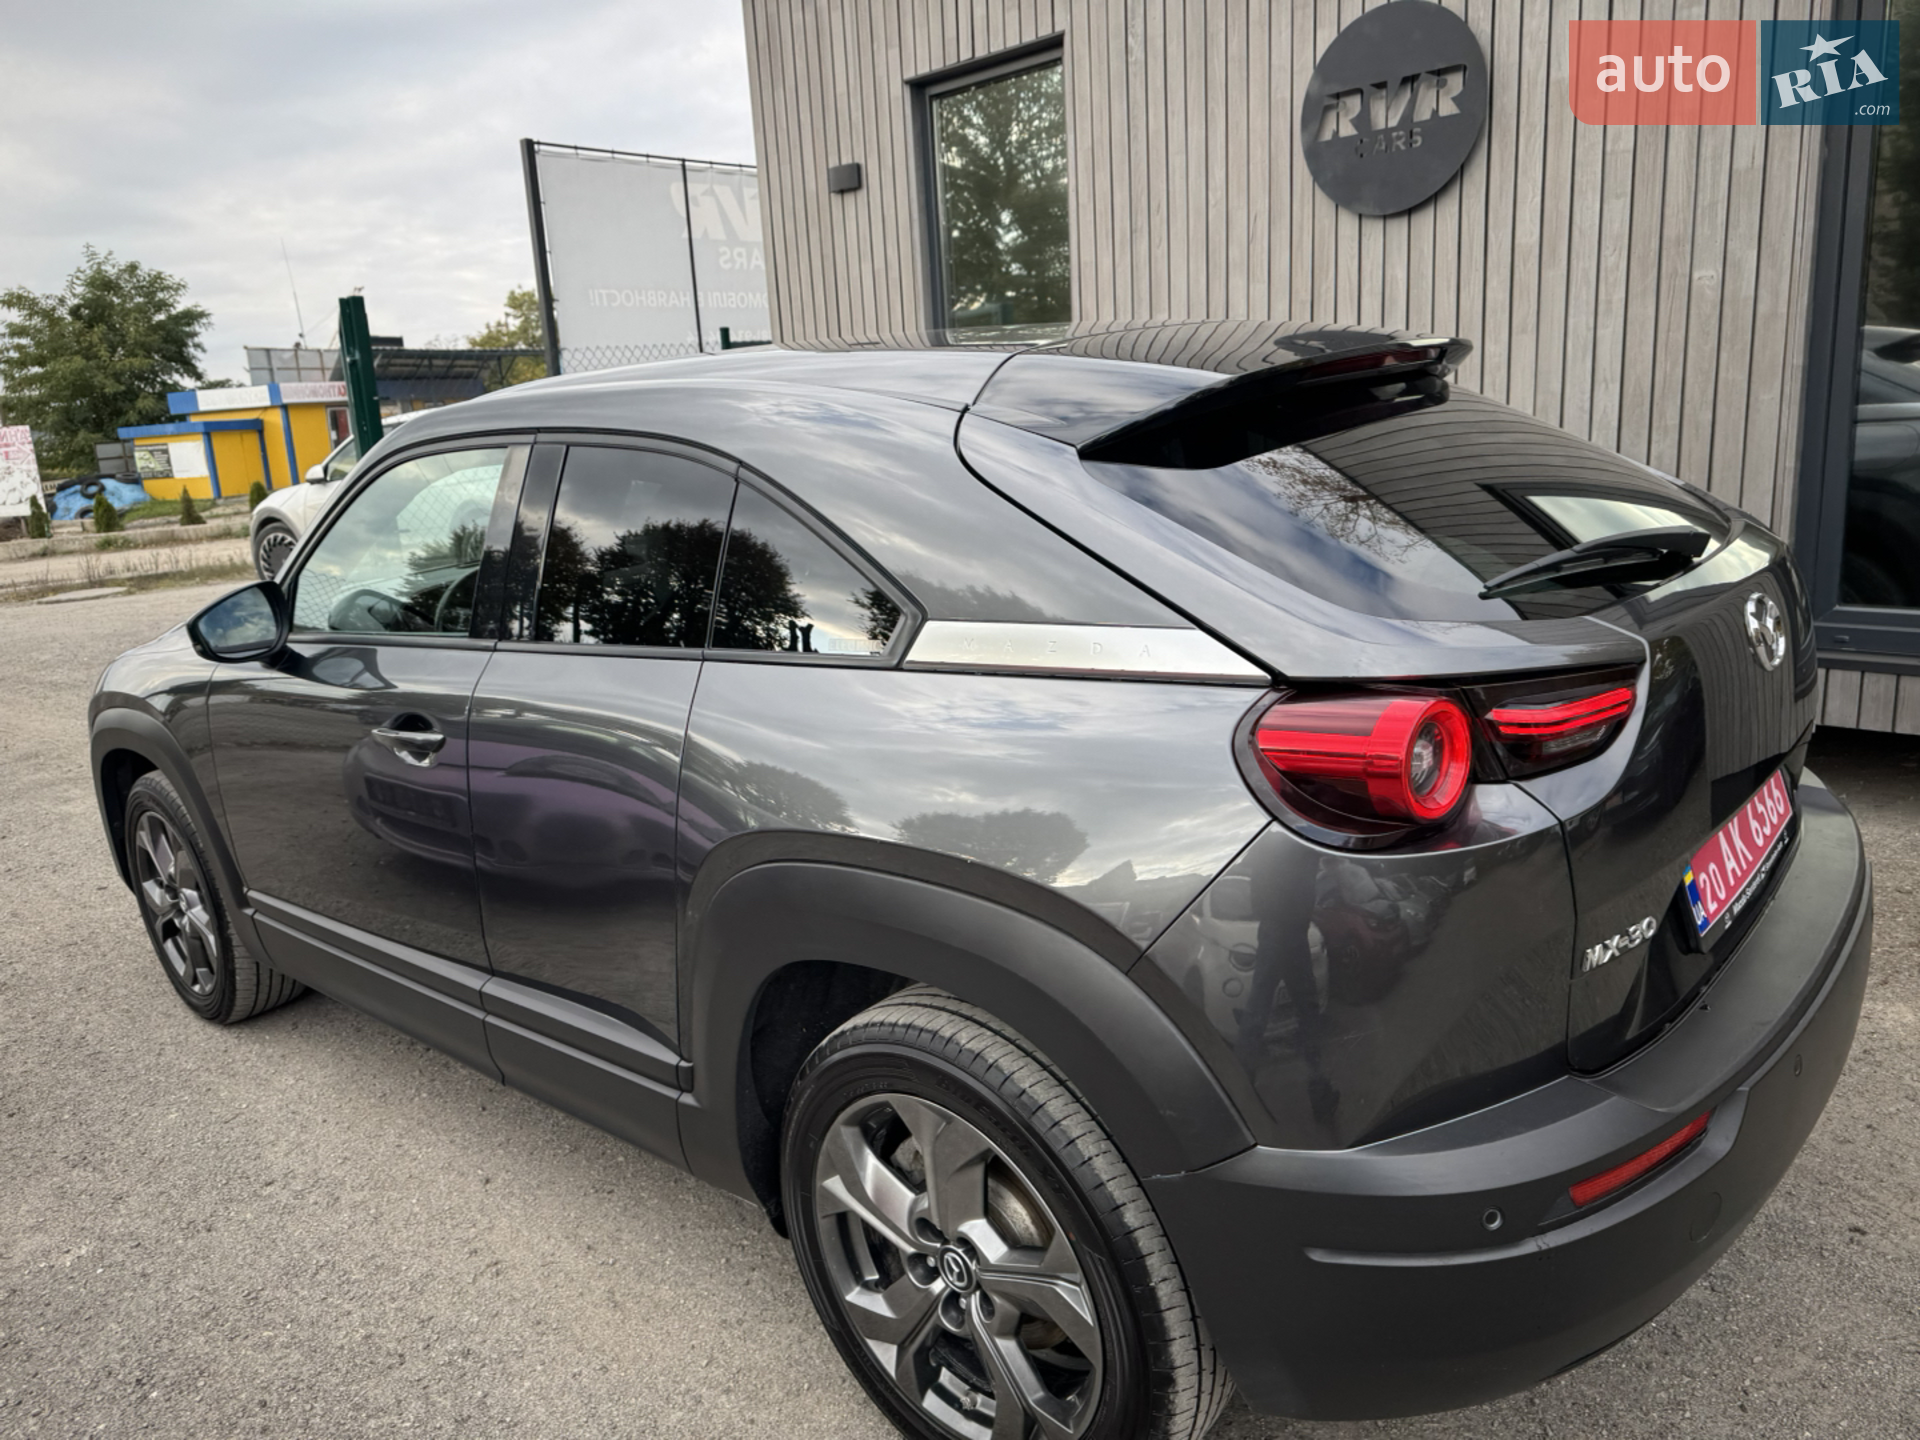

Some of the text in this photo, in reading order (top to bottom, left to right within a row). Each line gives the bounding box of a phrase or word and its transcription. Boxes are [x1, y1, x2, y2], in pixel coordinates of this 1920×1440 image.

[1316, 64, 1468, 142] RVR
[1355, 127, 1423, 158] CARS
[962, 638, 1151, 658] MAZDA
[1699, 862, 1726, 914] 20
[1718, 816, 1754, 887] AK
[1747, 777, 1785, 848] 6566
[1692, 901, 1707, 925] UA
[1582, 915, 1657, 972] MX-30
